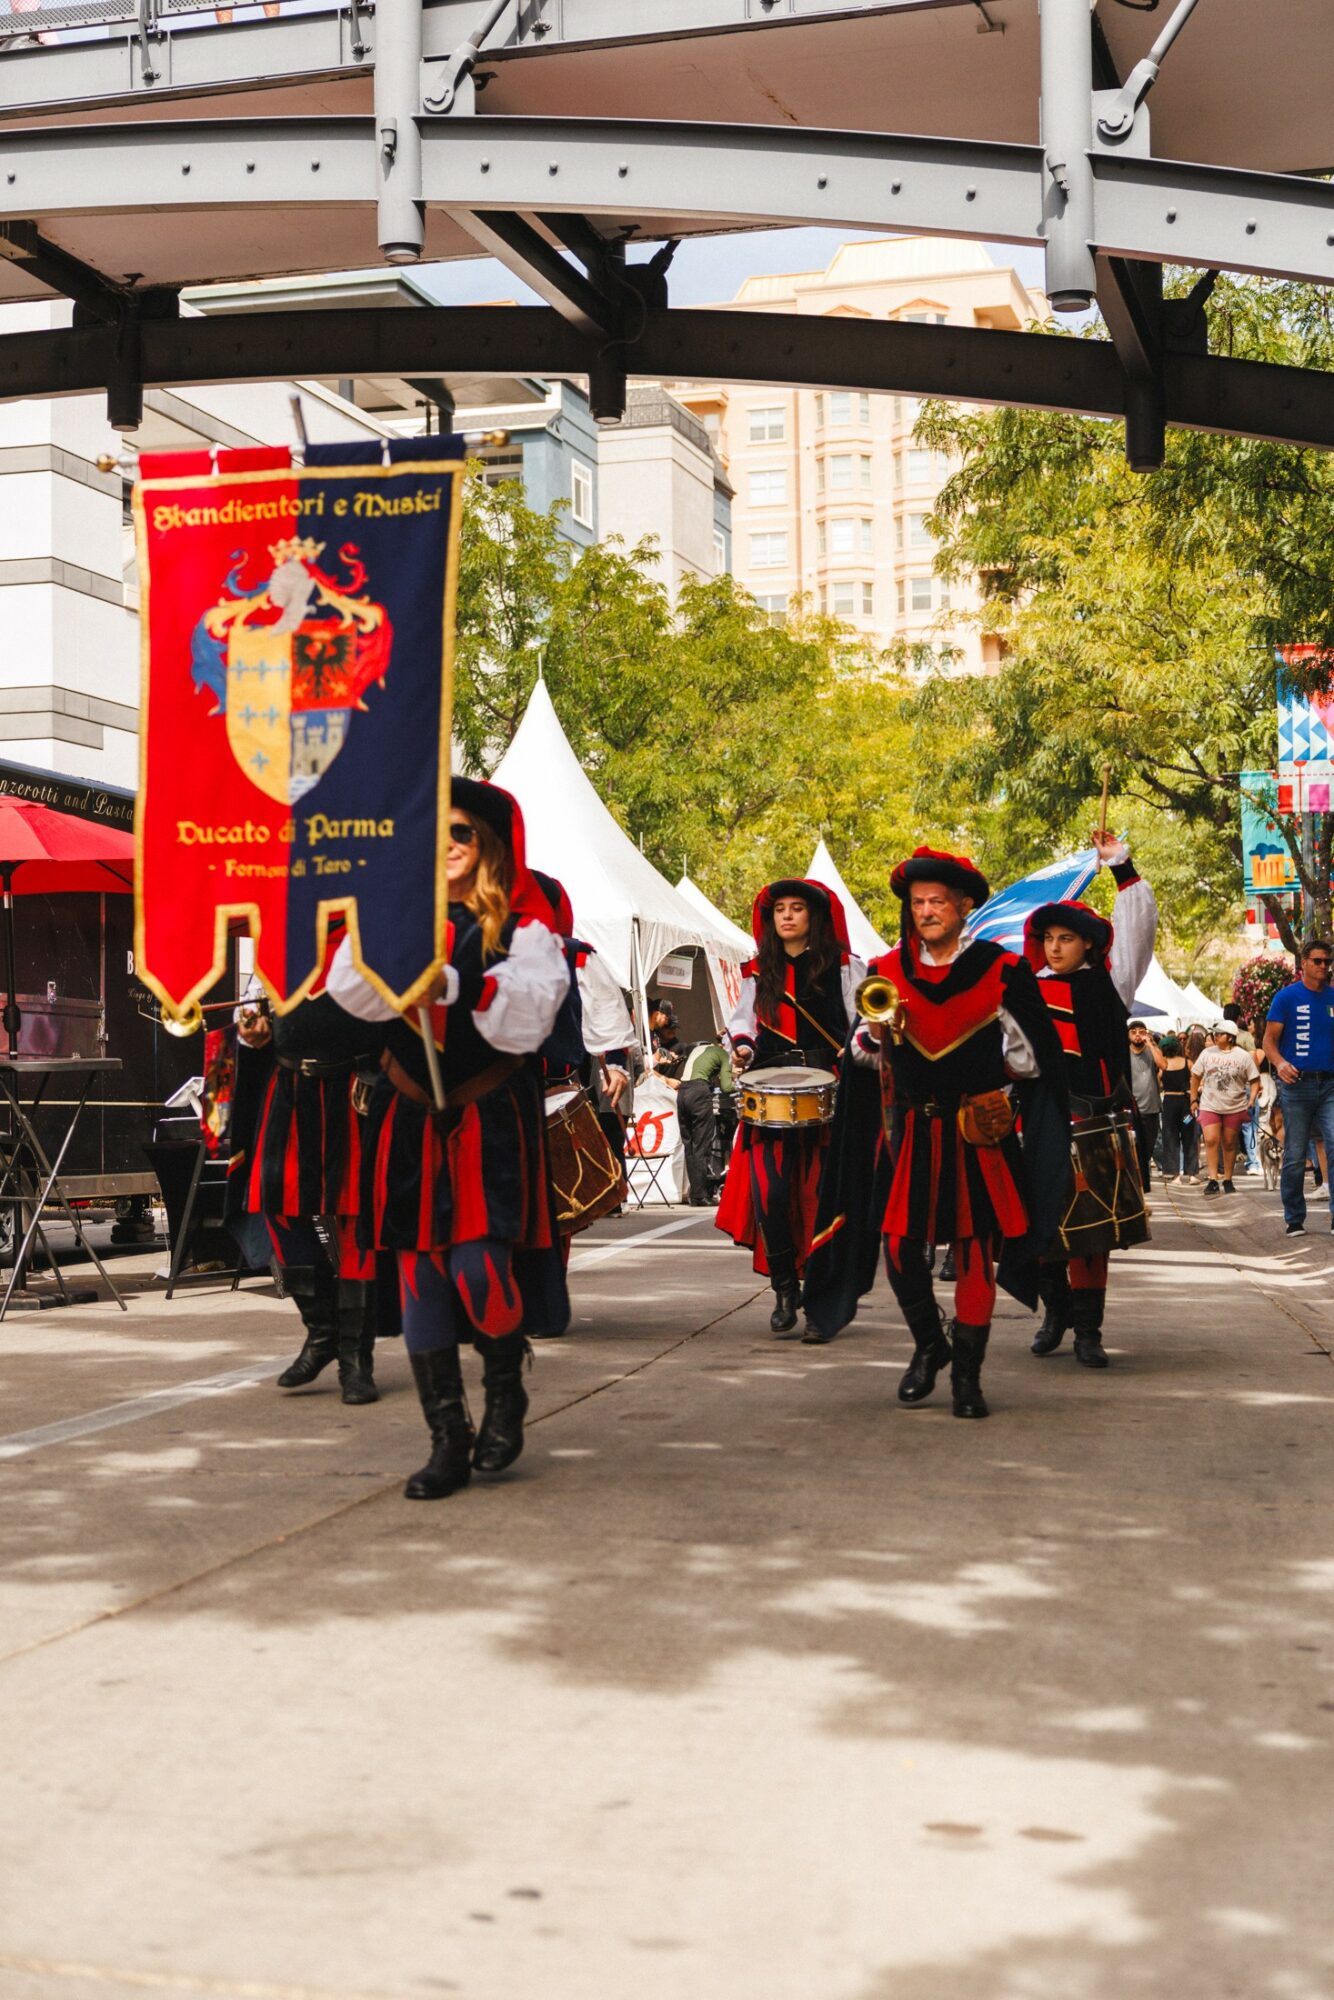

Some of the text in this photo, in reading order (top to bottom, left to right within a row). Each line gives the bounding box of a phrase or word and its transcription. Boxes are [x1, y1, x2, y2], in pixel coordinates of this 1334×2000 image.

[334, 499, 348, 515] e
[353, 488, 442, 517] Musici
[64, 789, 90, 810] and
[93, 793, 134, 820] Pasta
[176, 813, 395, 846] Ducato di Parma
[312, 855, 351, 875] Taro
[1295, 1004, 1311, 1057] ITALIA
